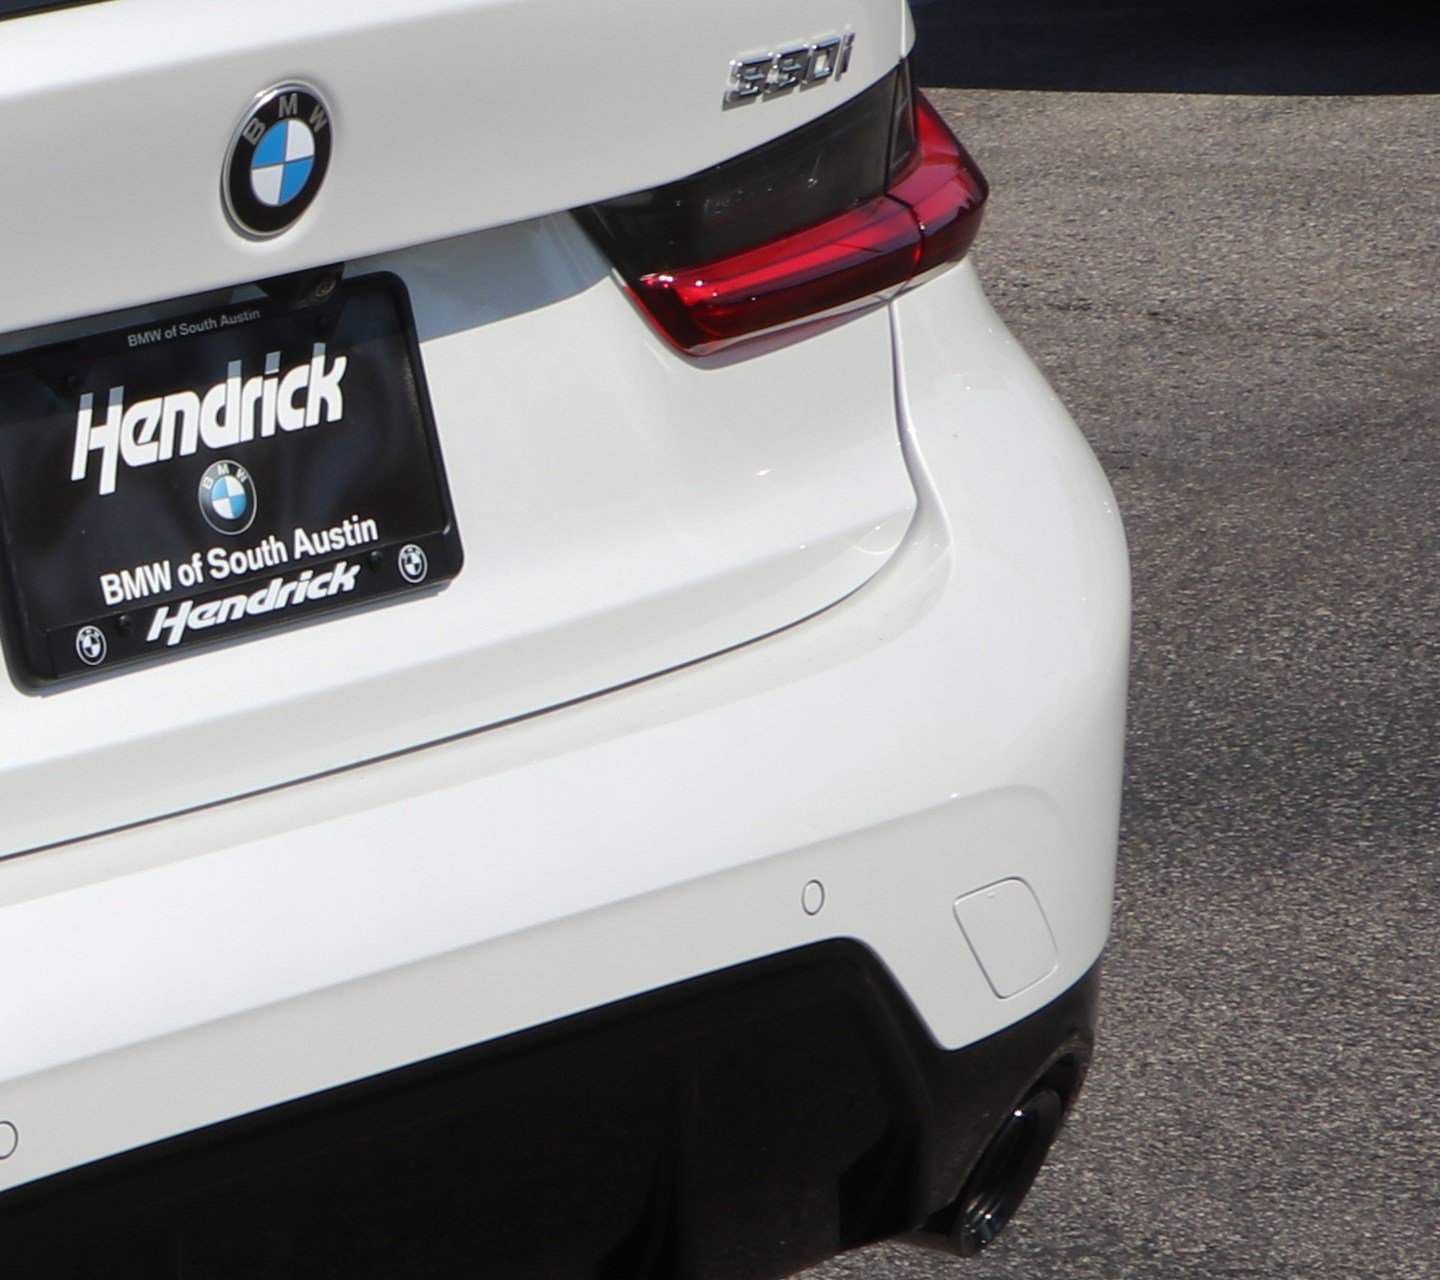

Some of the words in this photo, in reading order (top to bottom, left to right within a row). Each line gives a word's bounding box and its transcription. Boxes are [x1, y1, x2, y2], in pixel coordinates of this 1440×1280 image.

[724, 31, 856, 109] 330i
[242, 93, 328, 146] BMW
[128, 331, 162, 348] BMW
[164, 326, 178, 339] of
[180, 318, 217, 336] South
[219, 308, 261, 326] Austin
[71, 341, 347, 495] Hendrick
[203, 463, 249, 490] BMW
[100, 560, 173, 606] BMW
[178, 553, 204, 587] of
[207, 535, 288, 579] South
[293, 514, 379, 560] Austin
[146, 560, 361, 647] Hendrick
